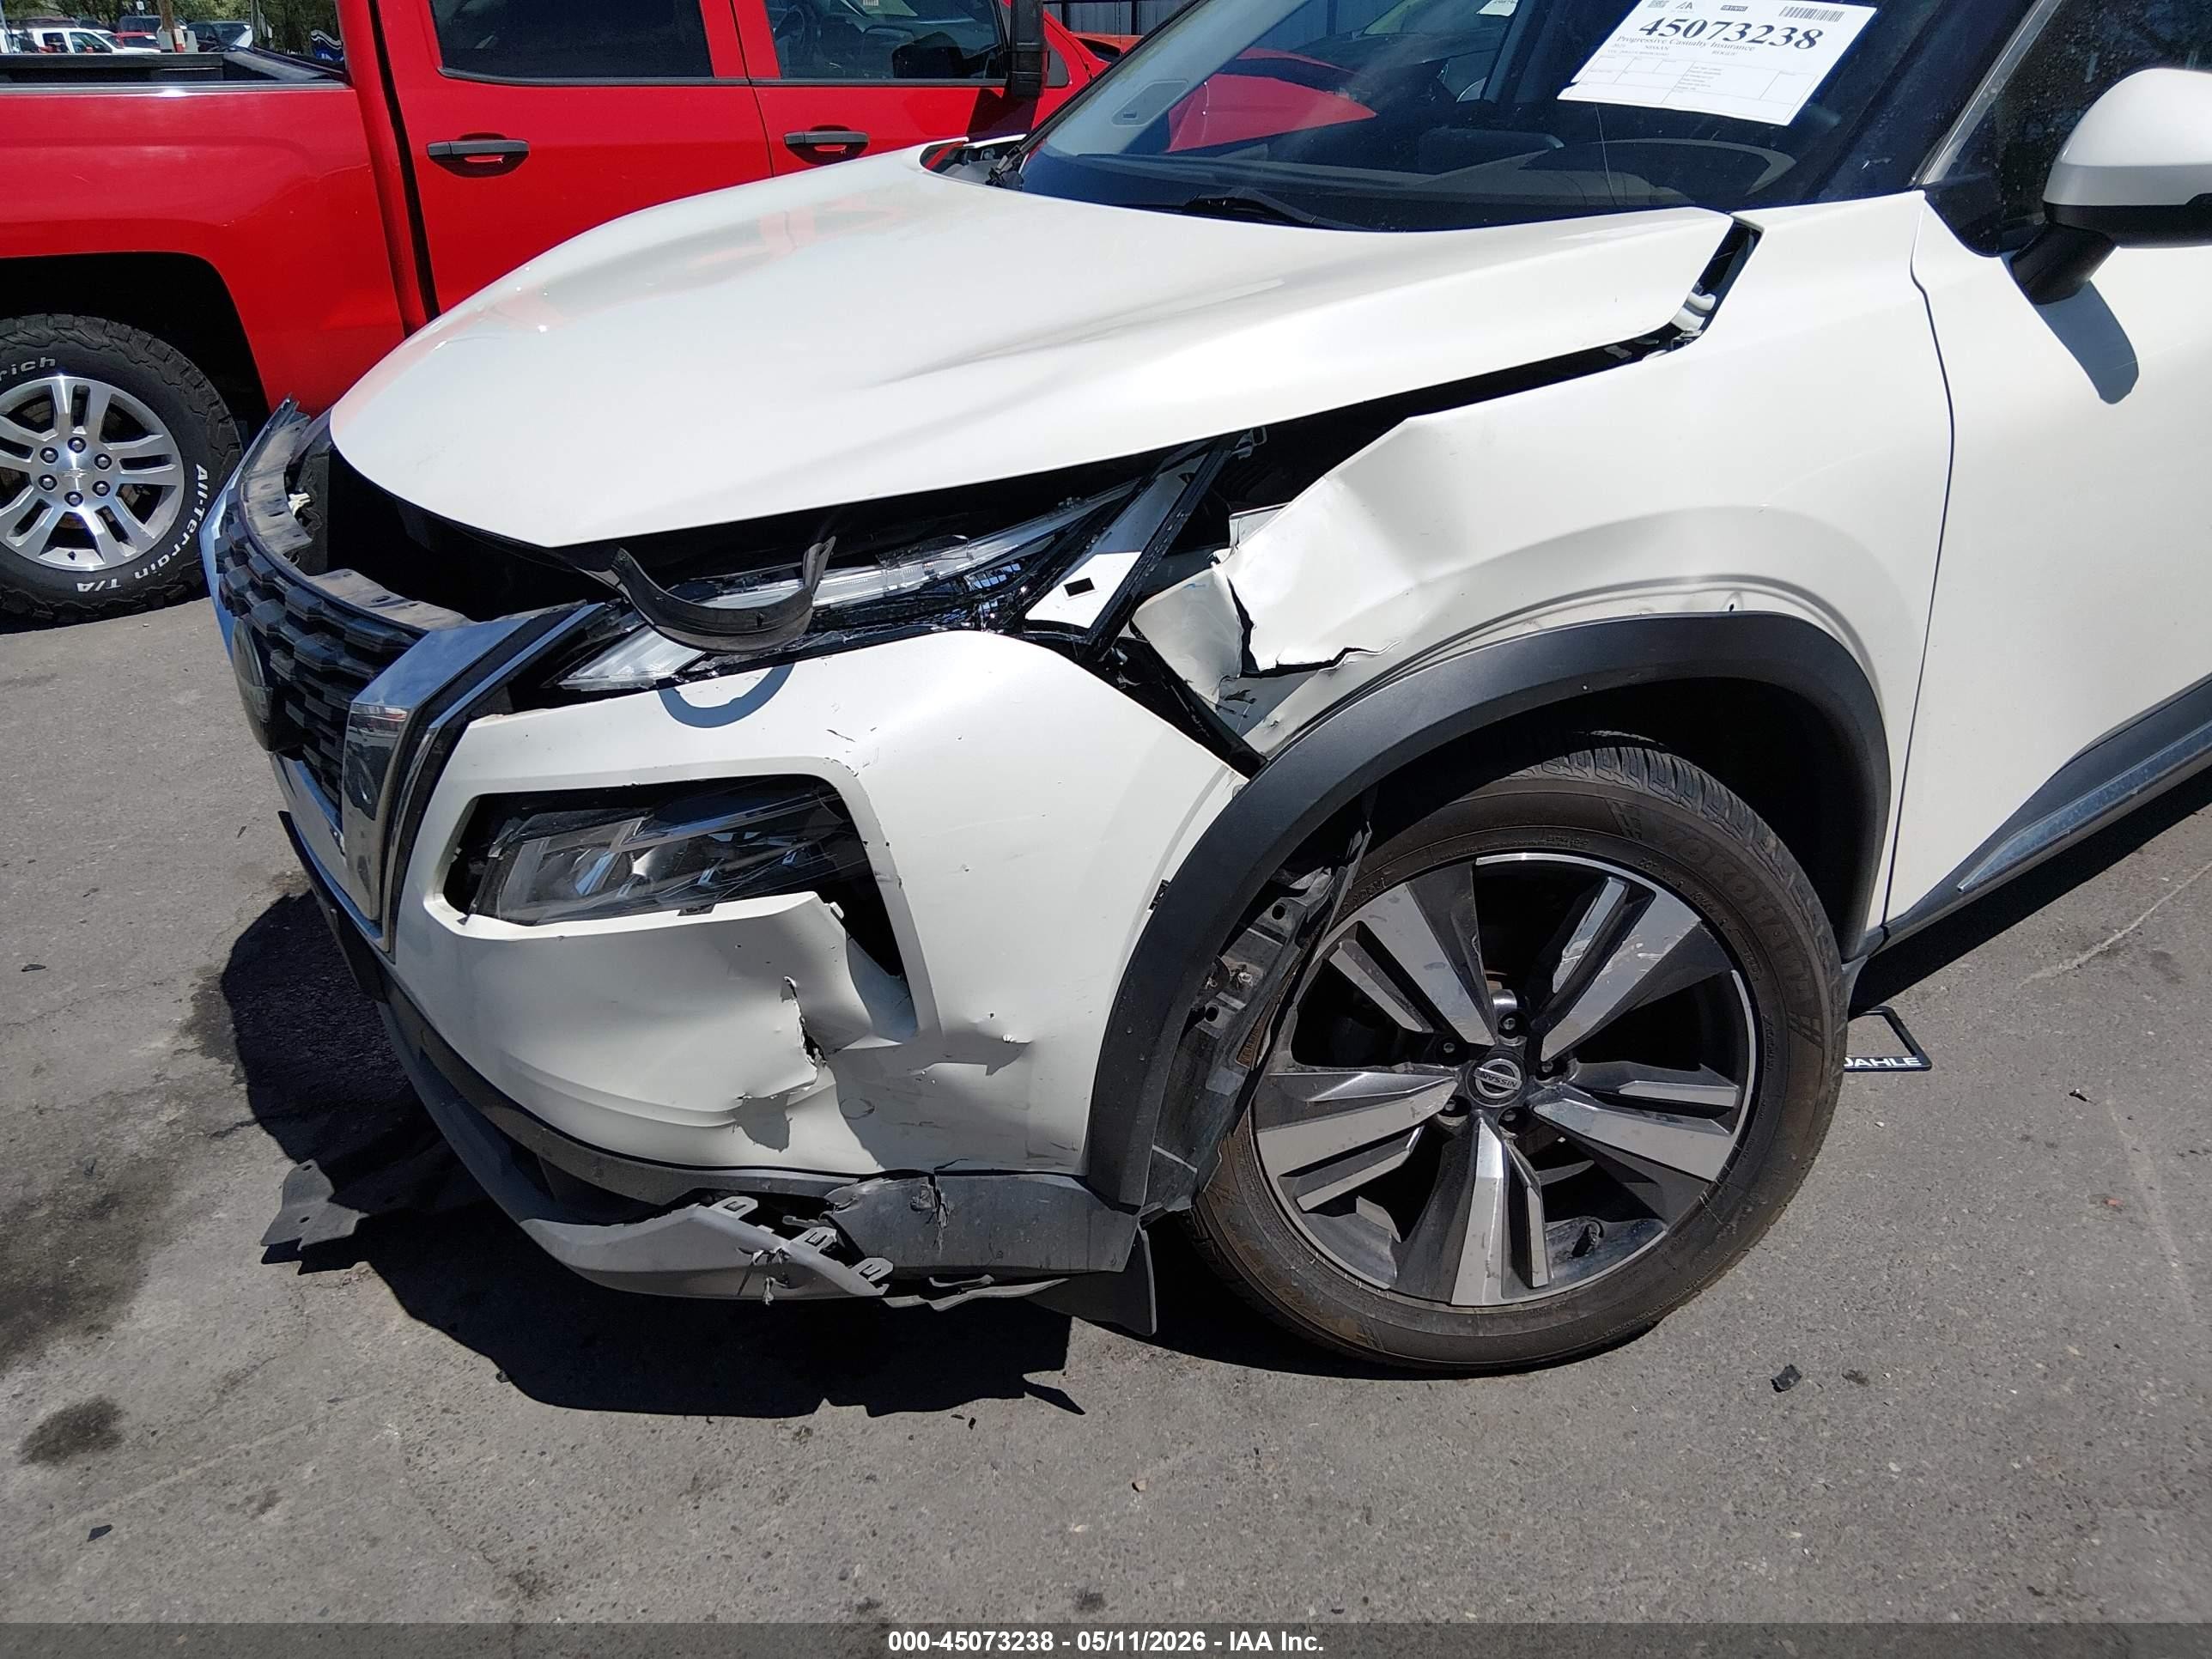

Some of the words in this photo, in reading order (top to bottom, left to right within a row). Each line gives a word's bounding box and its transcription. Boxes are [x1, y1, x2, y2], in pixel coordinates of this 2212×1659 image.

[1638, 16, 1824, 51] 45073238
[1617, 35, 1668, 45] Progressive
[1668, 39, 1708, 49] Casualty
[1710, 41, 1755, 52] Insurance
[134, 464, 210, 579] All-Terrain
[76, 578, 122, 593] T/A
[1481, 1072, 1517, 1087] NISSAN
